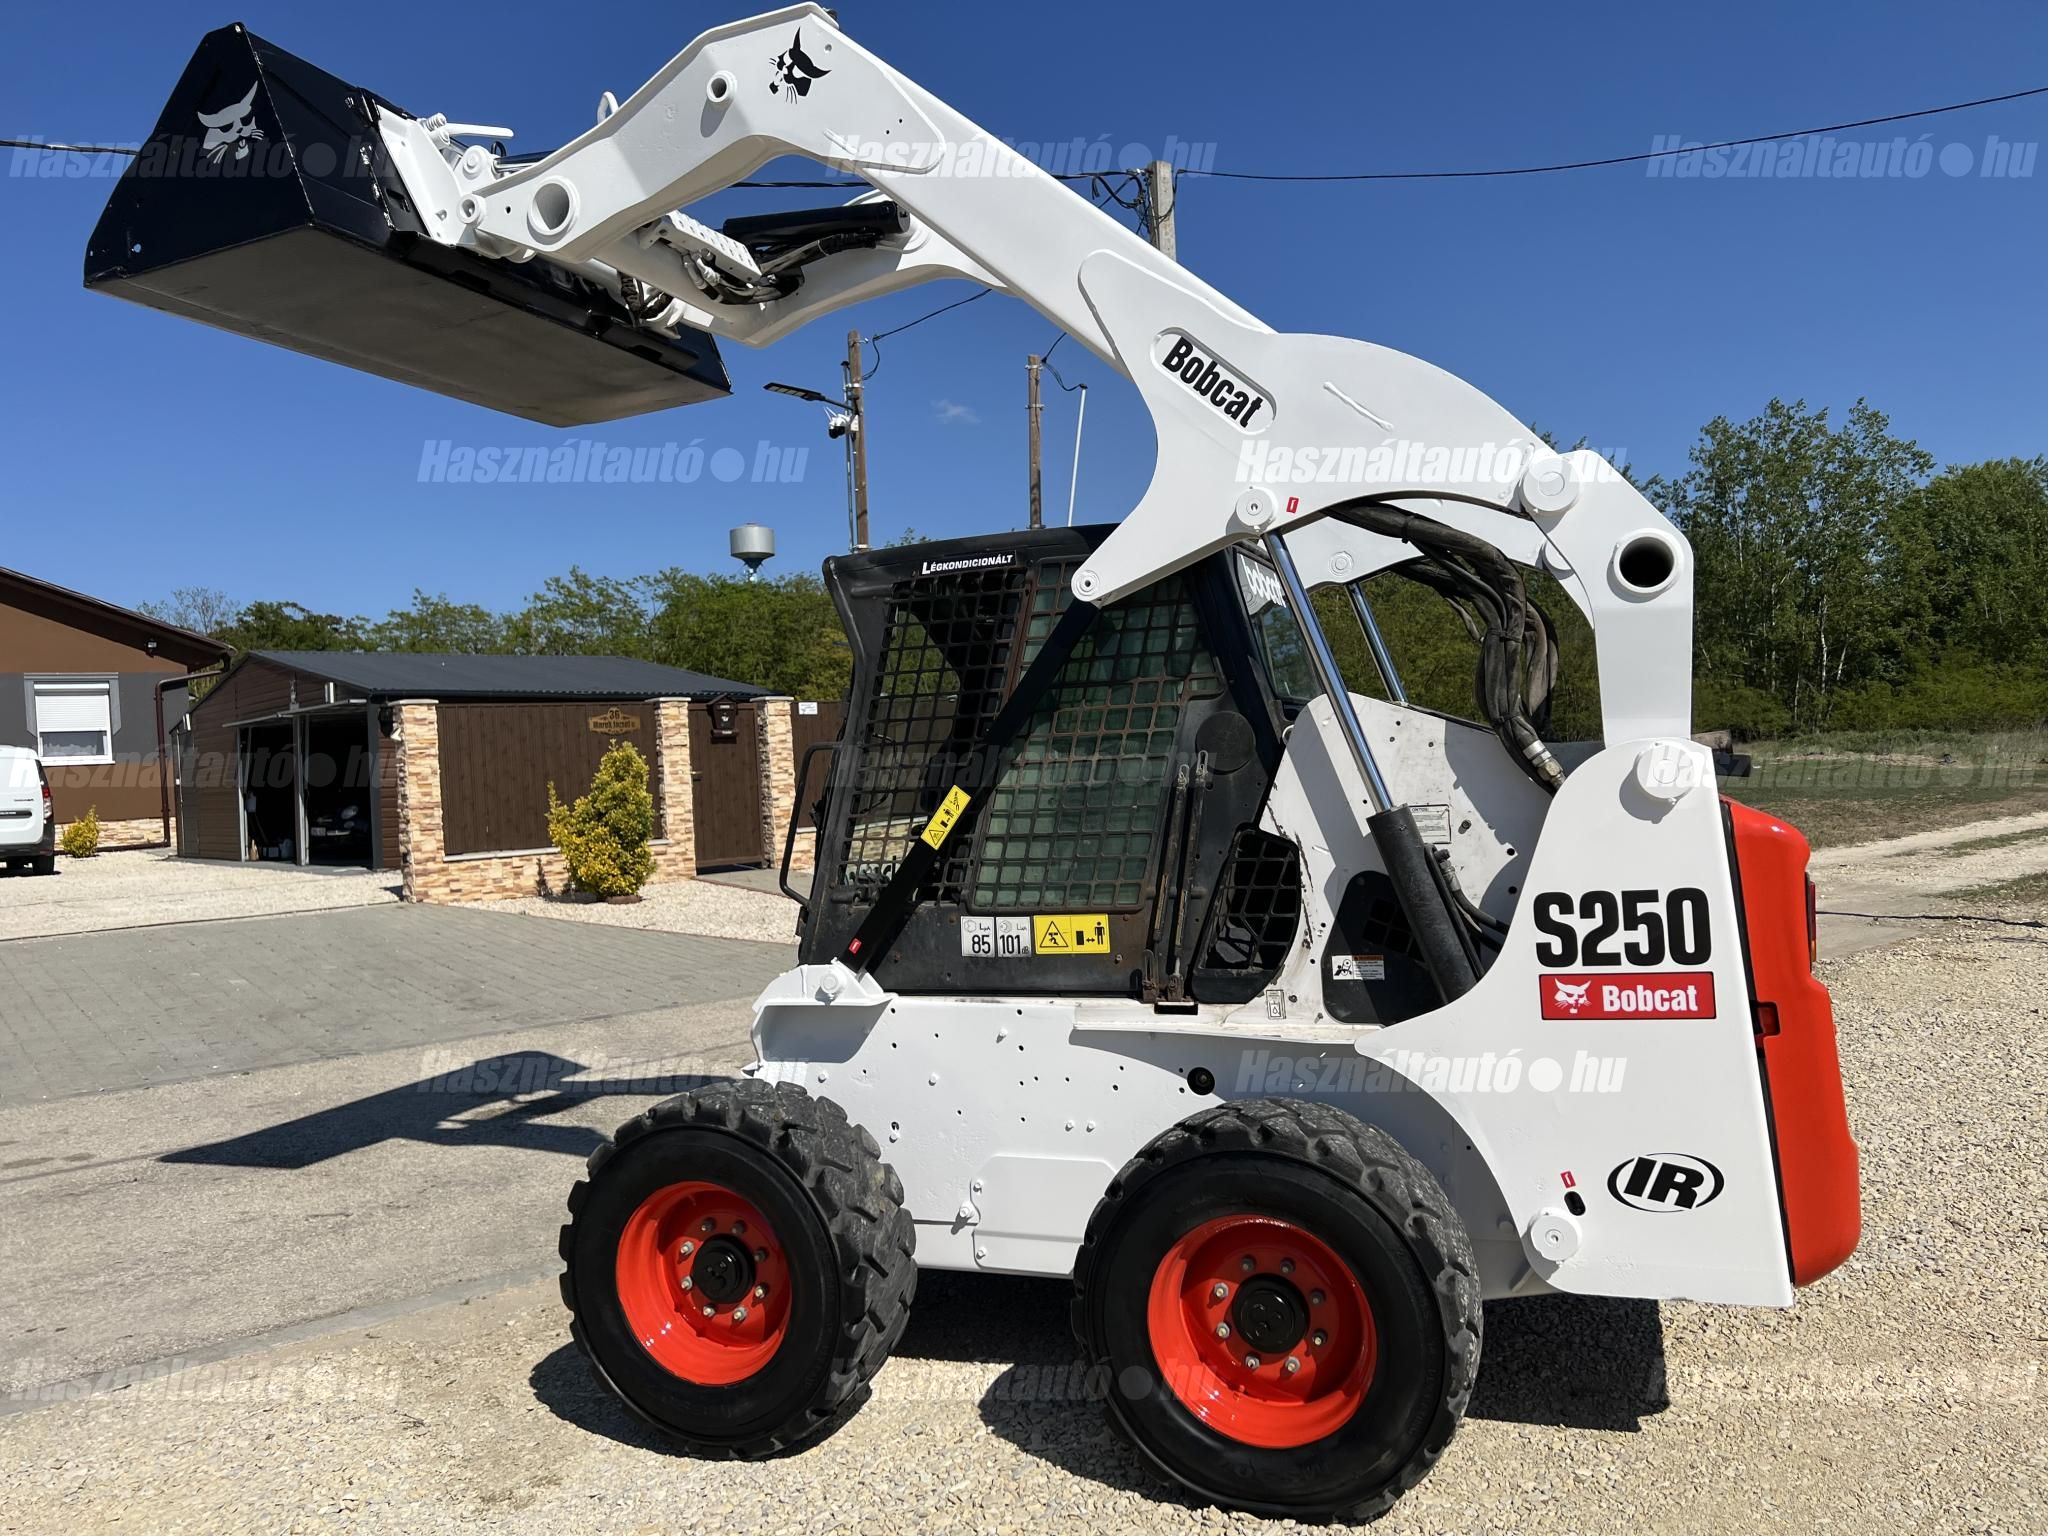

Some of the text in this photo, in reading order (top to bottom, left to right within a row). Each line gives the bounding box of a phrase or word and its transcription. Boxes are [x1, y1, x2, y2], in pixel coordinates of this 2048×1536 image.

[1162, 335, 1263, 428] Bobcat
[922, 553, 1013, 575] LÉGKONDICIONÁLT
[1533, 887, 1712, 968] S250
[971, 934, 991, 954] 85
[999, 934, 1021, 954] 101
[1601, 984, 1698, 1012] Bobcat
[1623, 1156, 1705, 1210] IR
